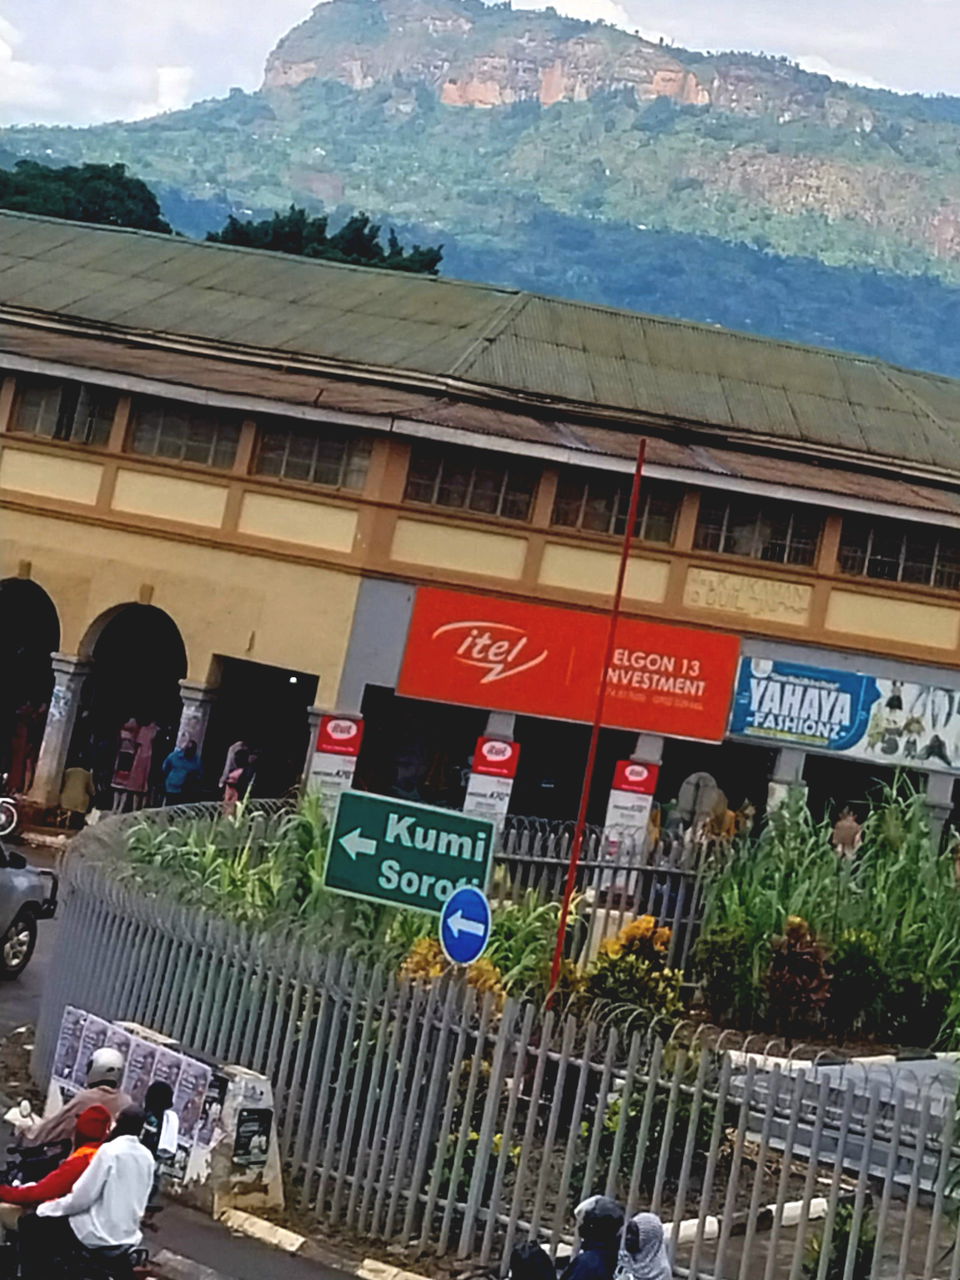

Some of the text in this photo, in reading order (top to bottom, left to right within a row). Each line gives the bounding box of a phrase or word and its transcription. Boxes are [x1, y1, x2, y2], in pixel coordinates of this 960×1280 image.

[456, 628, 528, 662] itel
[613, 648, 700, 677] ELGON 13
[606, 667, 706, 697] NVESTMENT
[750, 678, 851, 726] YAHAYA
[384, 813, 487, 862] Kumi
